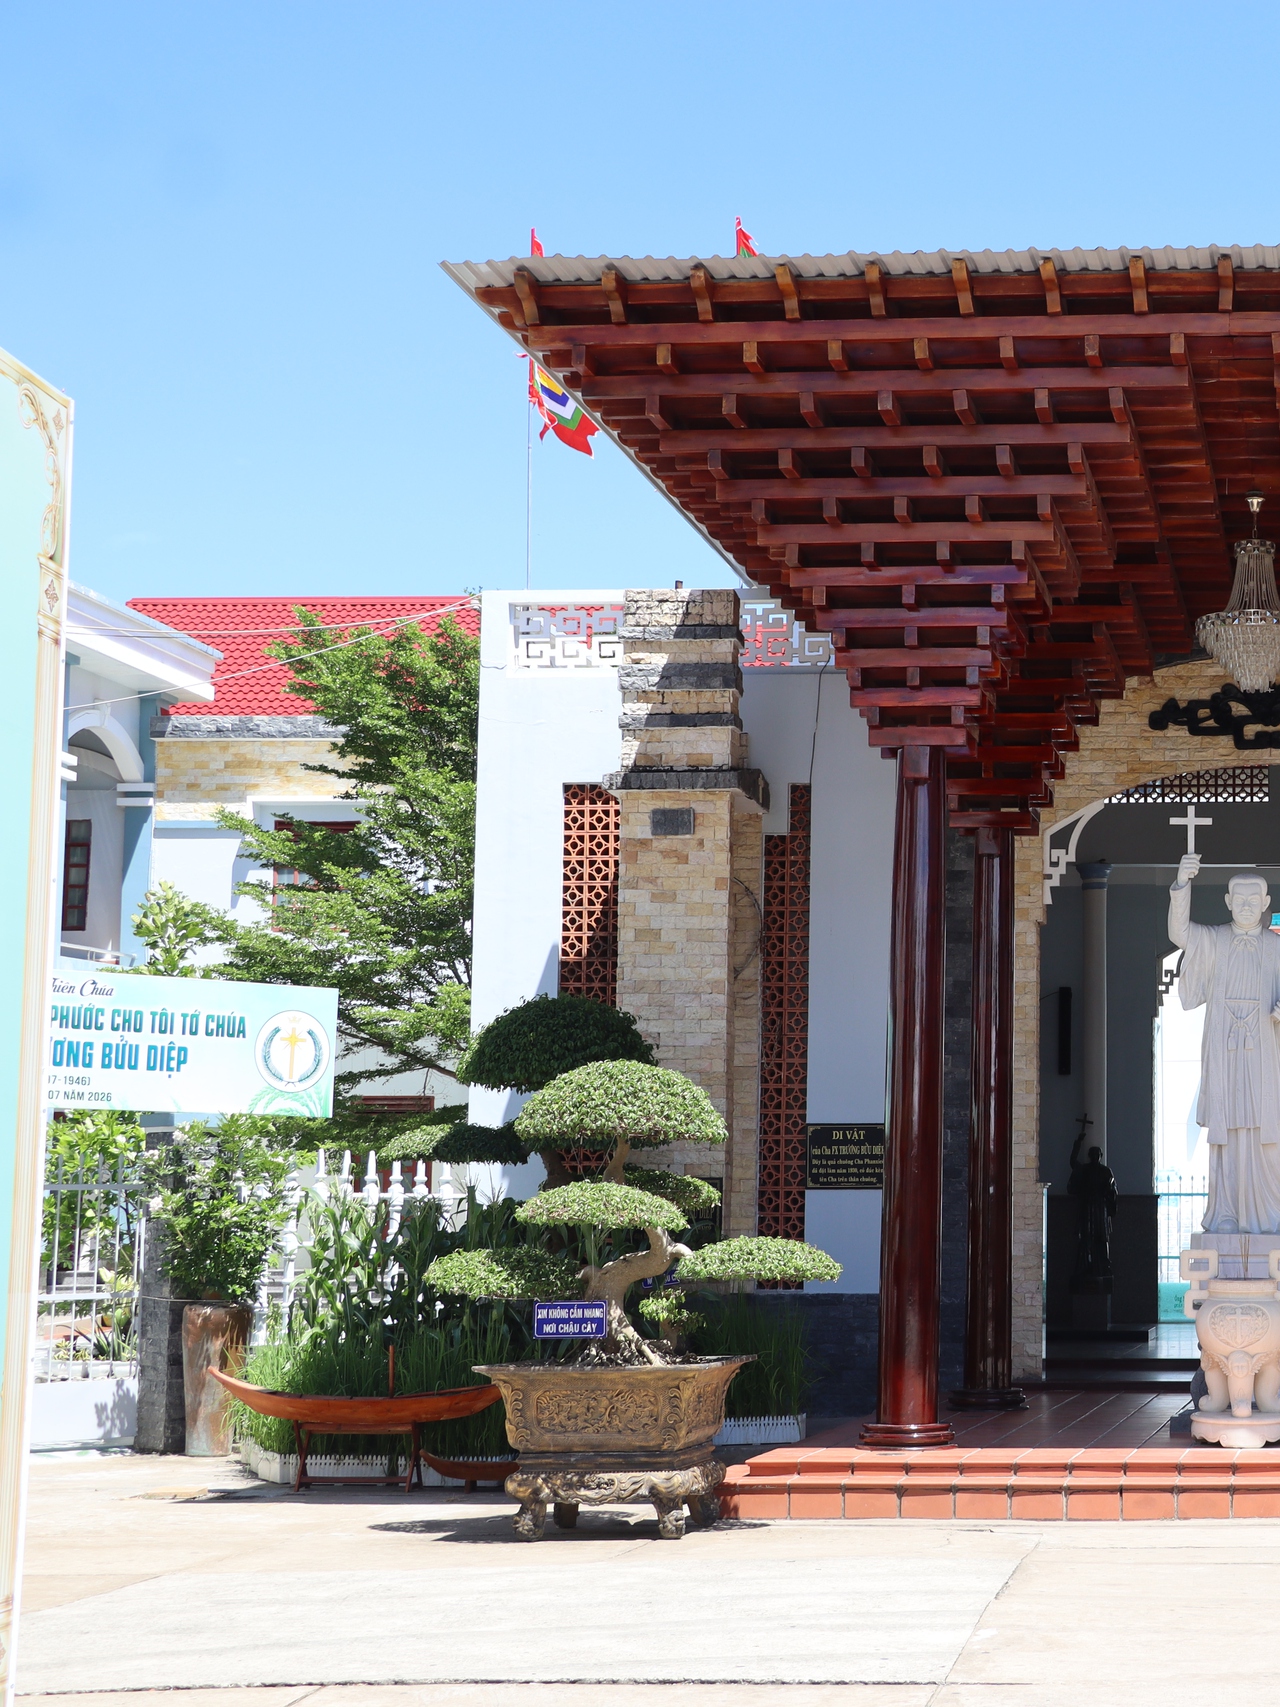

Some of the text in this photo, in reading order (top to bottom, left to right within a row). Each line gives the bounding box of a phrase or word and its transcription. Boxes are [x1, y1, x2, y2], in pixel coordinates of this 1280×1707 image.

[79, 979, 114, 997] Chúa
[50, 1003, 247, 1039] PHƯỚC CHO TÔI TỚ CHÚA
[49, 1034, 188, 1079] ƠNG BỬU DIỆP
[63, 1089, 85, 1101] NĂM
[88, 1092, 112, 1102] 2026
[832, 1127, 866, 1142] DI VẬT
[537, 1308, 548, 1319] XIN
[548, 1306, 569, 1319] KHÔNG
[583, 1308, 604, 1319] NHANG
[543, 1321, 598, 1335] NƠI CHẬU CÂY
